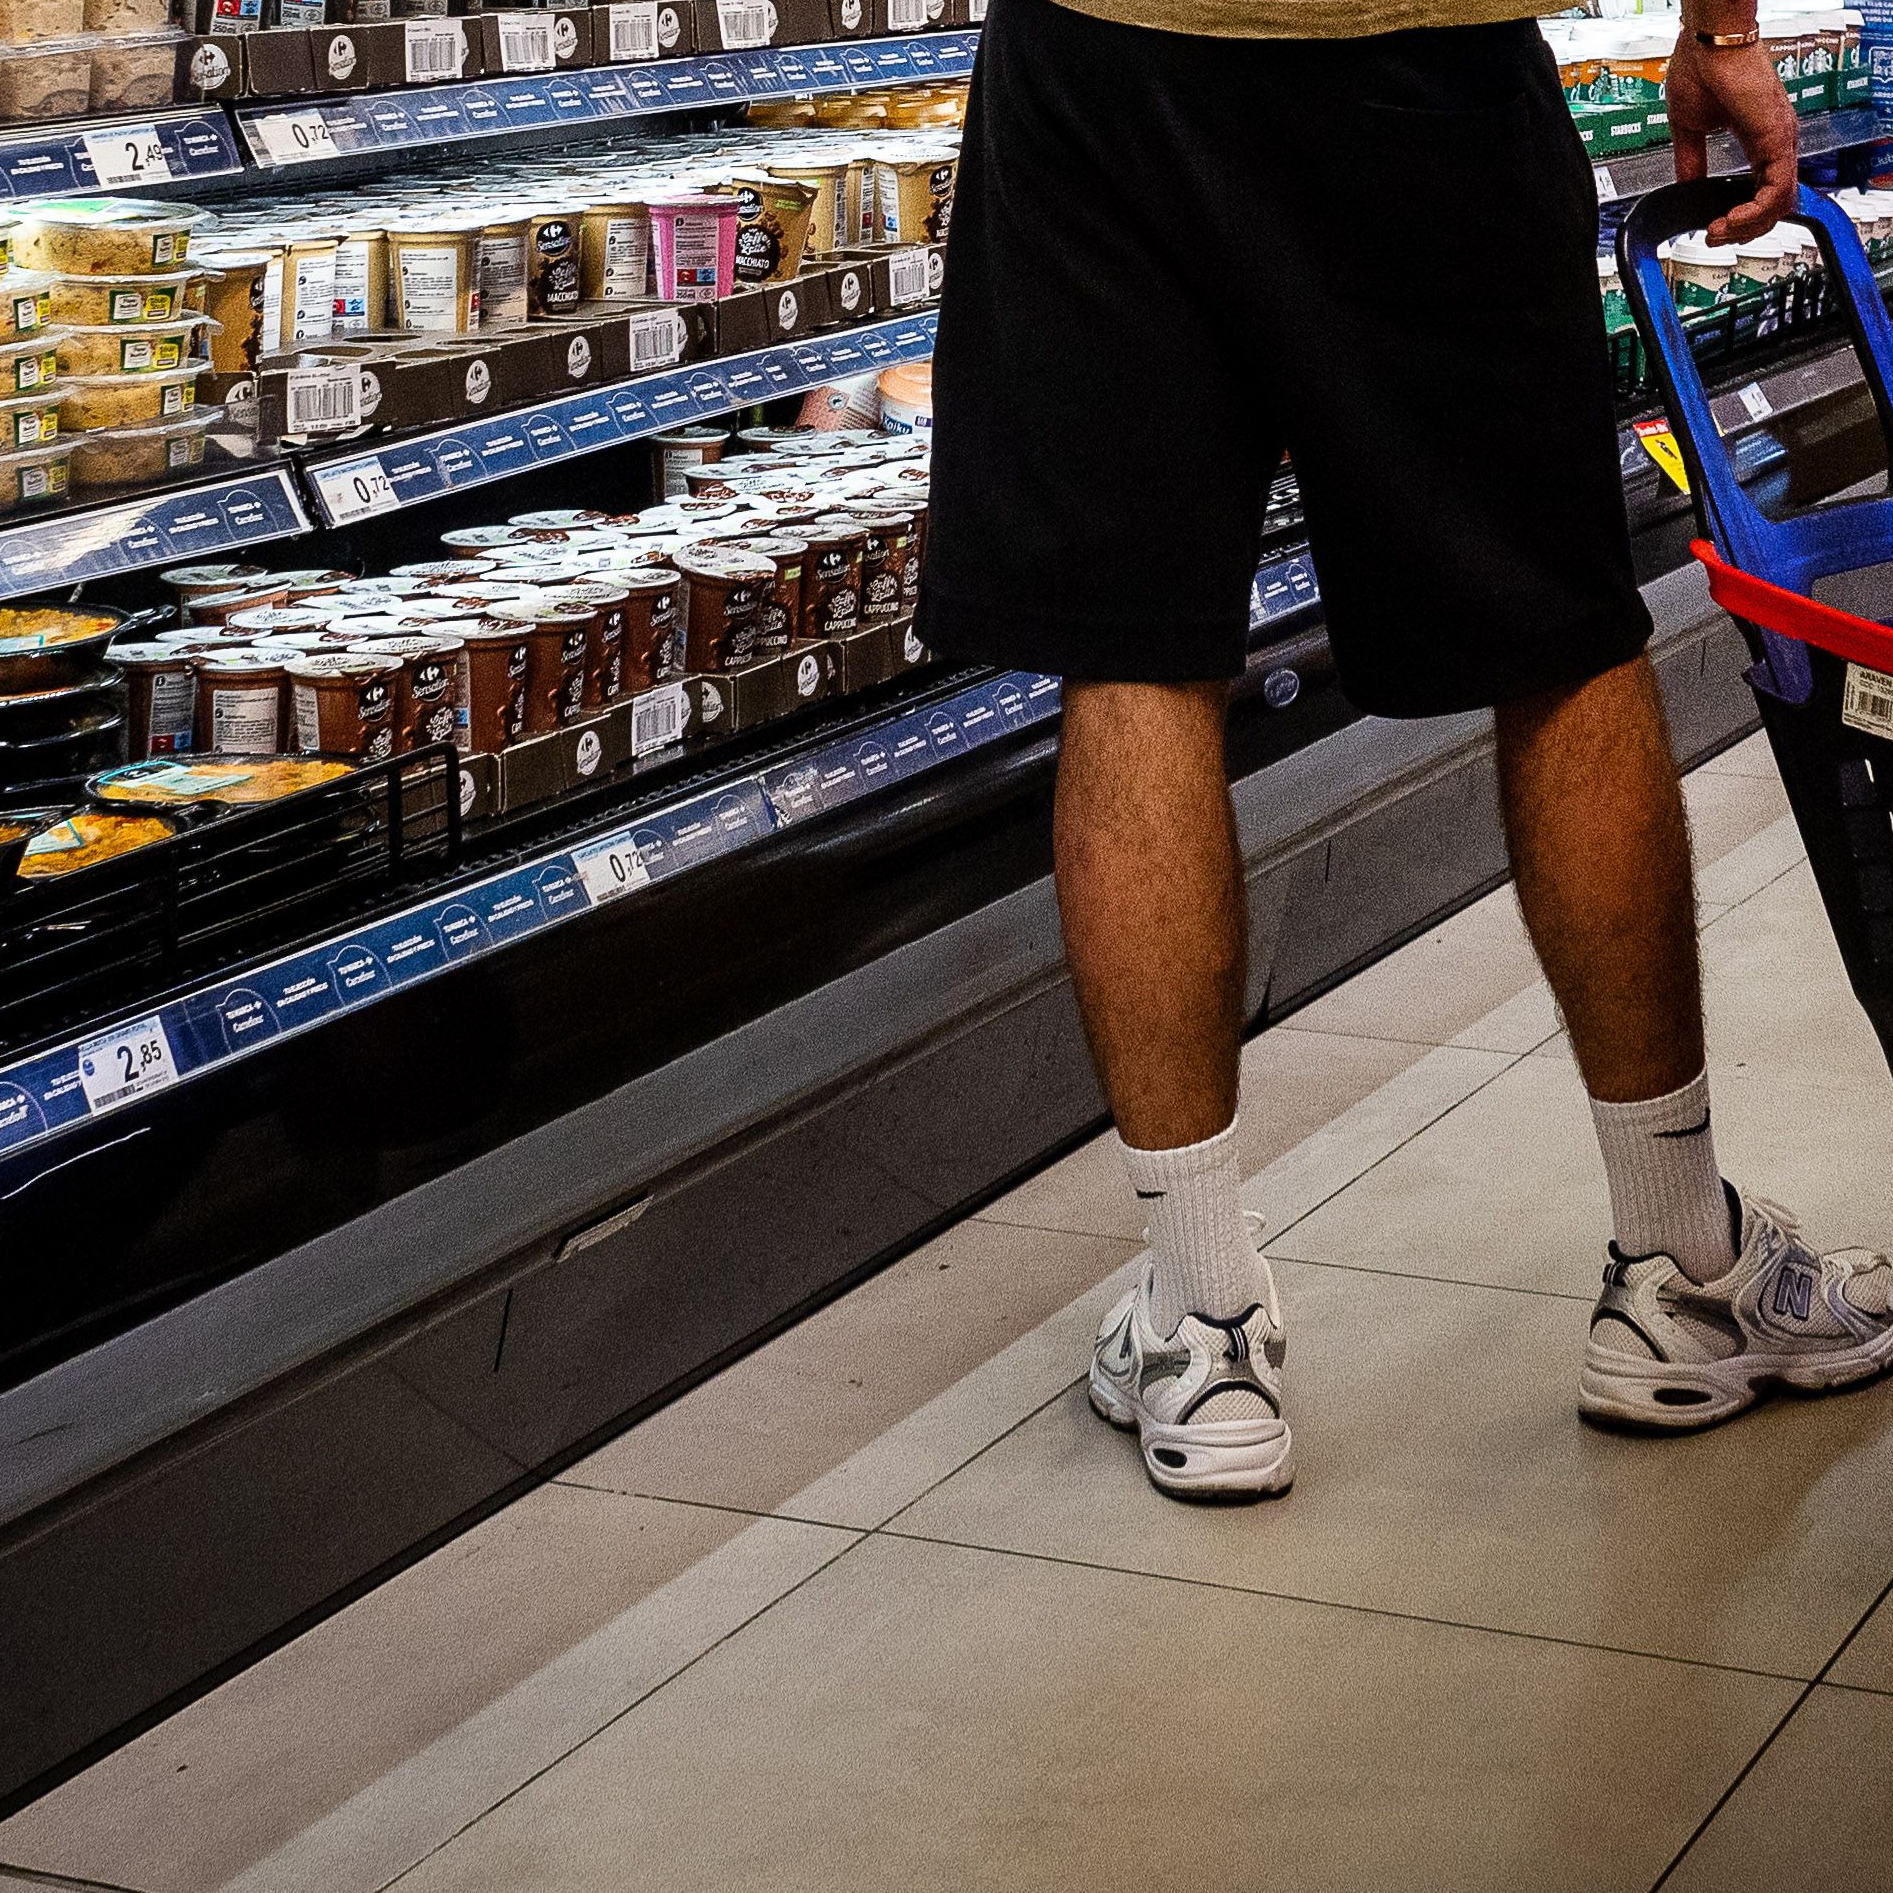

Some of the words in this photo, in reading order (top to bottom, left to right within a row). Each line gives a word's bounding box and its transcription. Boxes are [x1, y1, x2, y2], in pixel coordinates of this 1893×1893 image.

[291, 120, 329, 151] 0,72
[124, 141, 163, 171] 2,49
[736, 254, 770, 270] MACCHIATO
[546, 289, 579, 304] MACCHIAT
[353, 475, 391, 504] 0,72
[863, 602, 899, 615] CAPPUCCINO
[116, 1039, 162, 1083] 2,85
[1772, 1264, 1813, 1322] N
